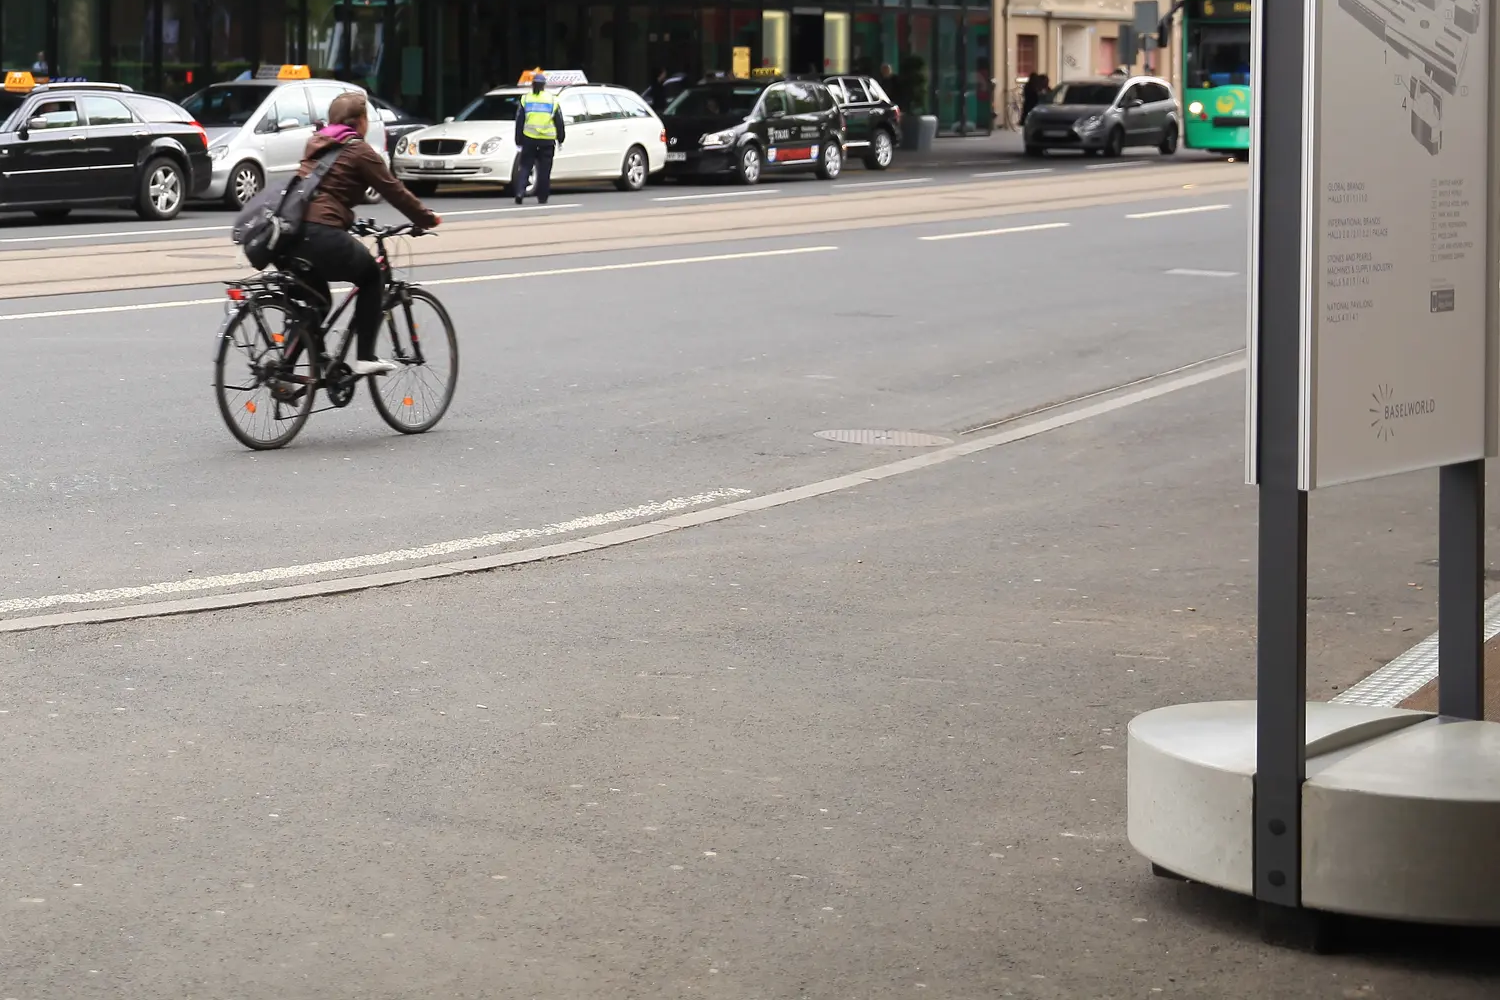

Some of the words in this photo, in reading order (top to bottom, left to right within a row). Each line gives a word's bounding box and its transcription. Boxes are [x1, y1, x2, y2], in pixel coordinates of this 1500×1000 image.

[8, 77, 26, 85] TAXI
[1400, 96, 1408, 112] 4
[1384, 398, 1436, 420] BASELWORLD
